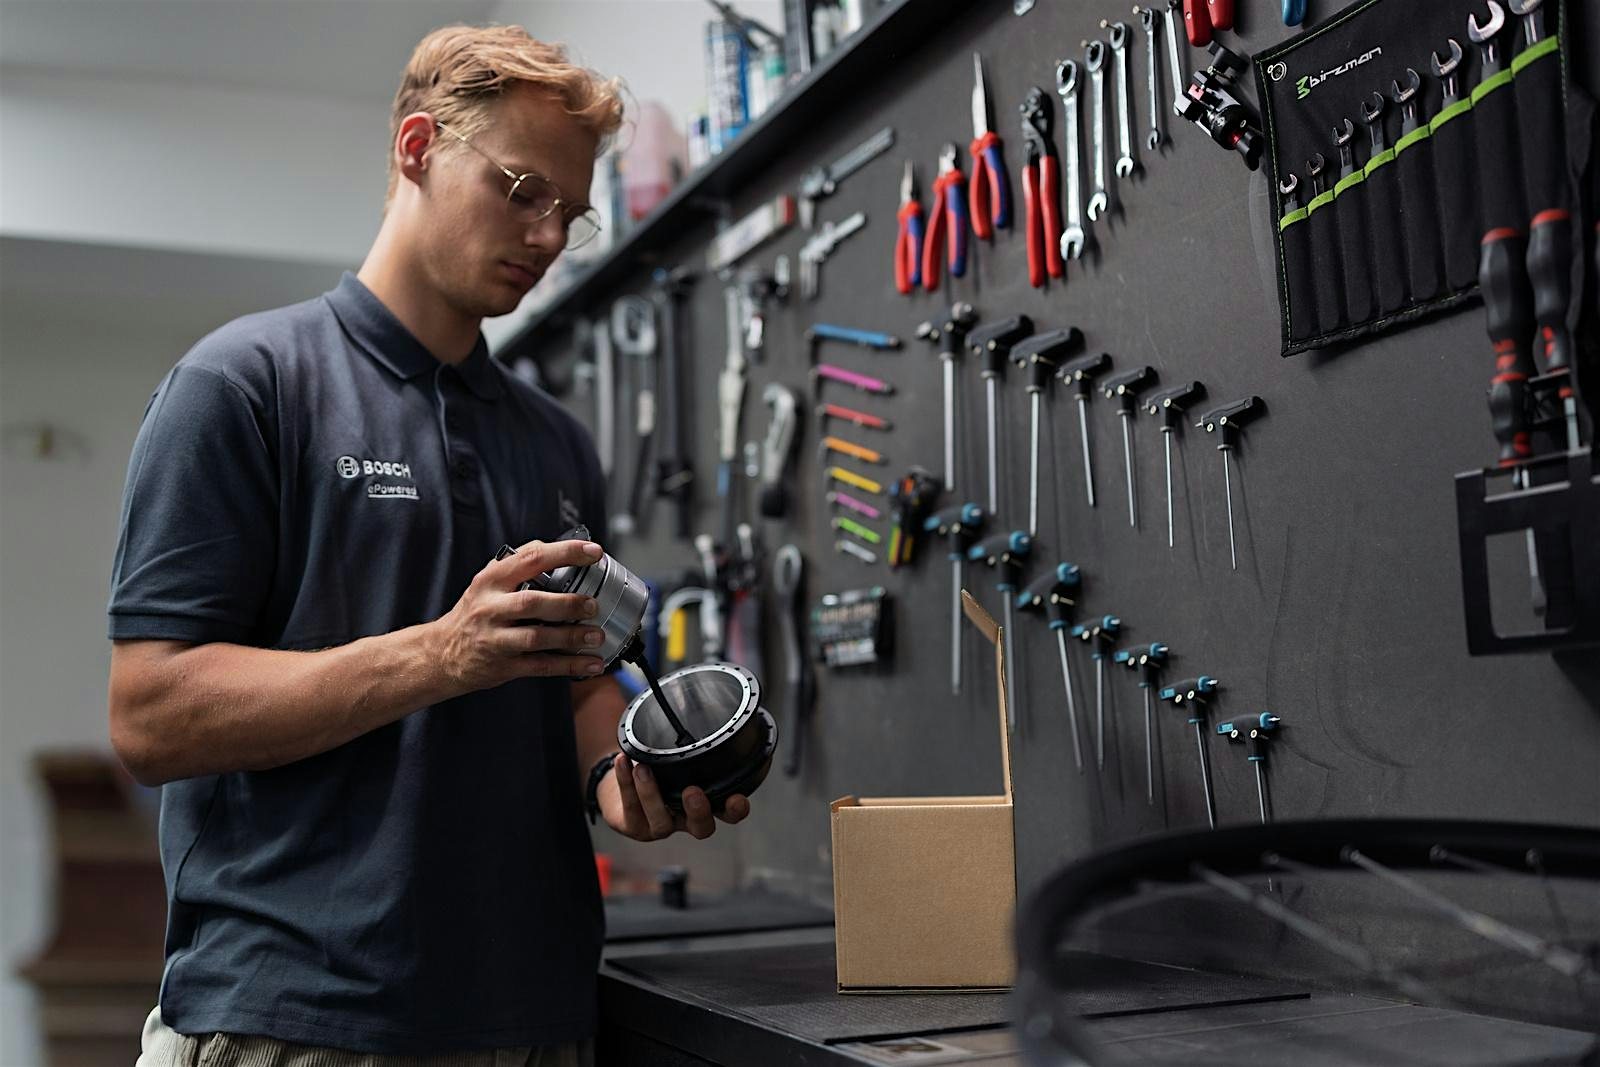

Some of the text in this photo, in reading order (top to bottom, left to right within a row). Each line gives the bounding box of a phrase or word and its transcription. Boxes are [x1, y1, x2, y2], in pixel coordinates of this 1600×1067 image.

[1309, 47, 1382, 88] birzman
[362, 460, 411, 478] BOSCH
[368, 484, 417, 496] ePowered
